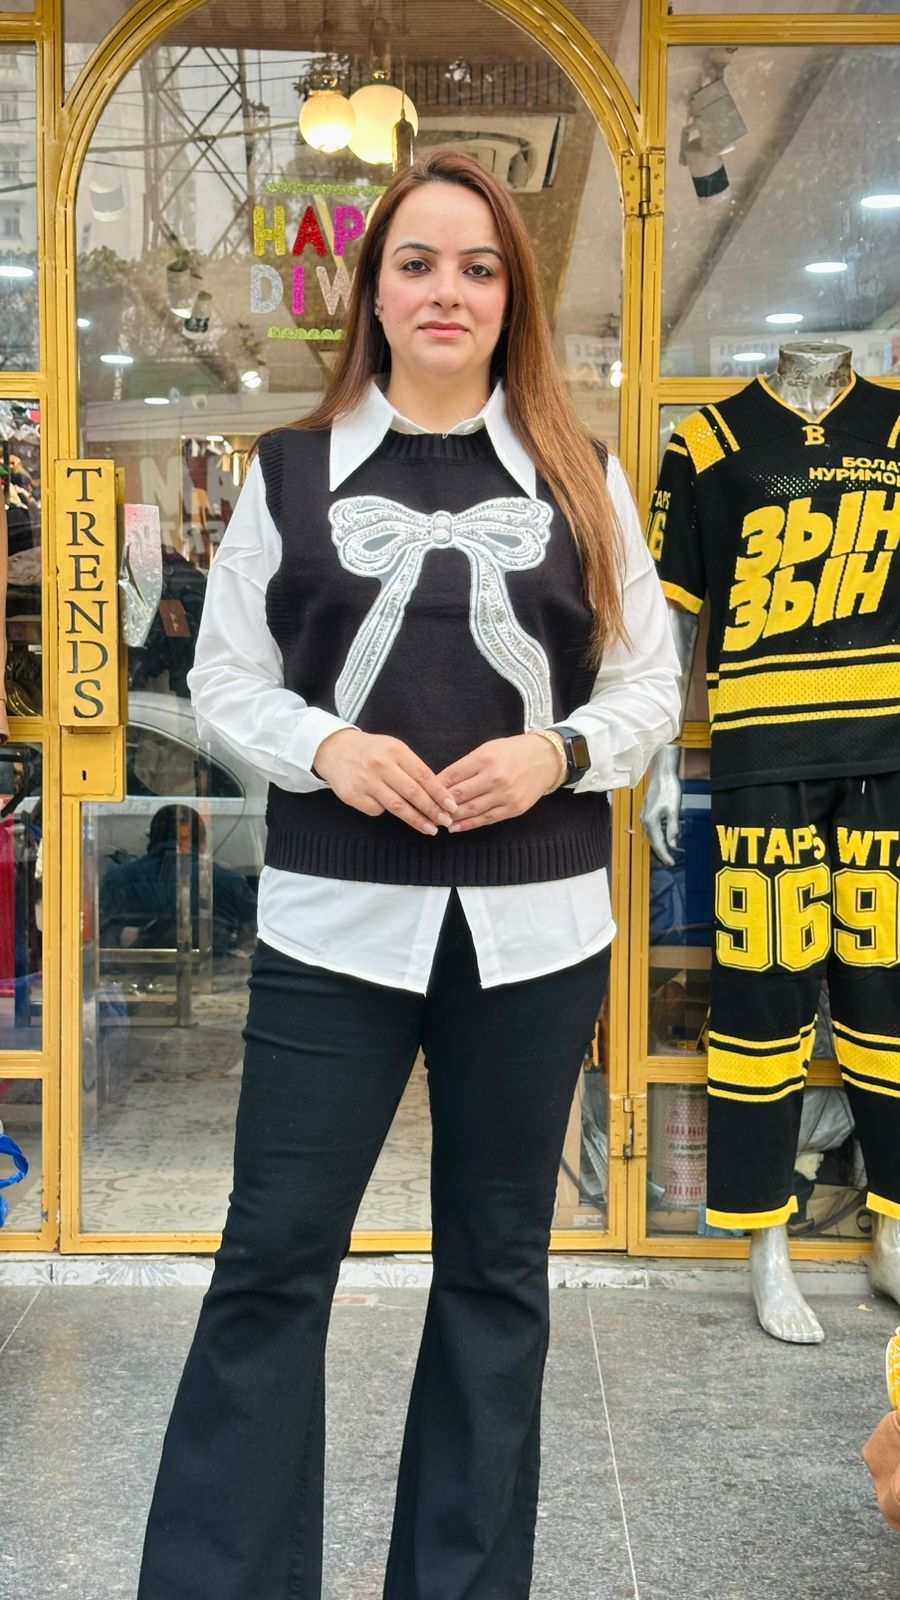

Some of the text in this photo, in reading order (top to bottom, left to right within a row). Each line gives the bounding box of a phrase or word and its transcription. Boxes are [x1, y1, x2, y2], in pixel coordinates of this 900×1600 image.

[253, 205, 365, 257] HAP
[250, 264, 356, 316] DIW
[802, 424, 826, 447] B
[842, 456, 900, 473] БОЛА
[645, 510, 667, 562] 6
[64, 467, 109, 719] TRENDS
[722, 551, 894, 652] ЗЫН
[716, 824, 826, 865] WTAPS
[836, 827, 900, 867] WT
[715, 863, 832, 972] 96
